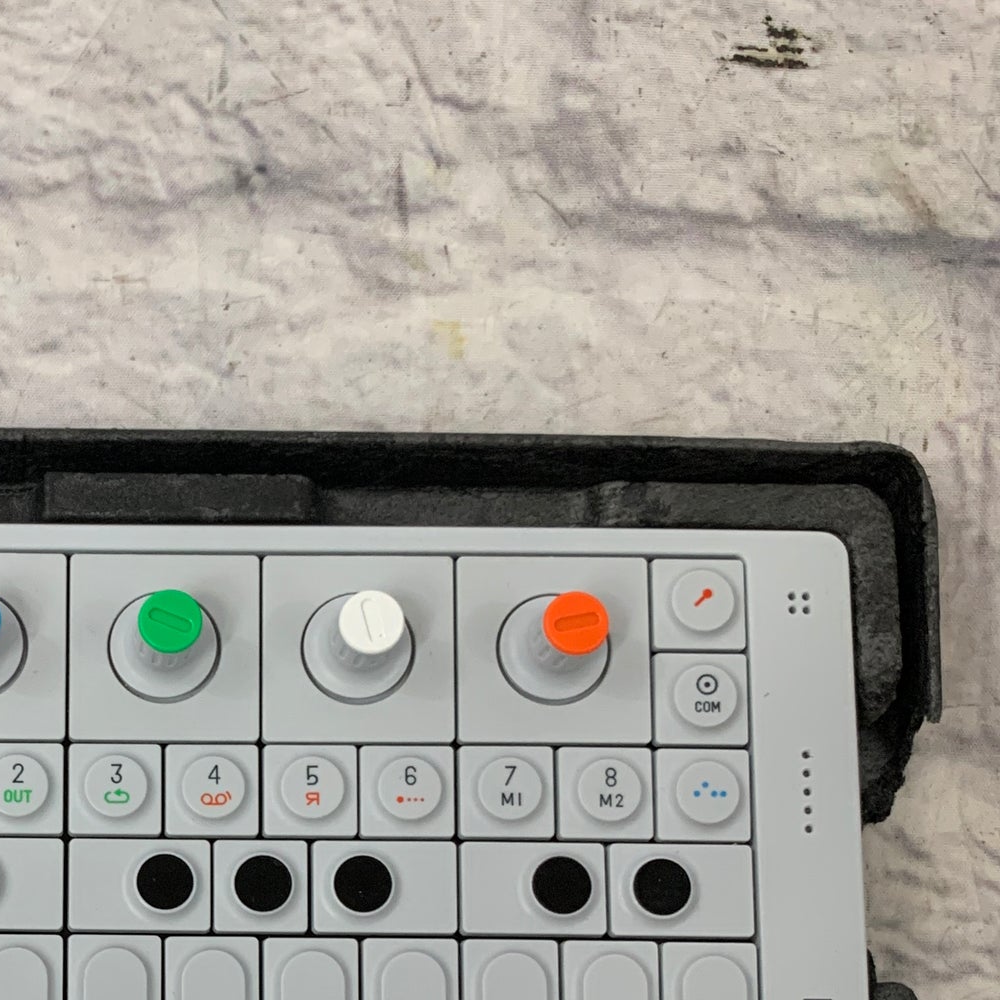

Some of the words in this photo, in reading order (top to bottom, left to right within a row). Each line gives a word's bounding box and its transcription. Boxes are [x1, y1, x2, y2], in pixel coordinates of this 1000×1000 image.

[695, 702, 721, 713] COM
[12, 763, 24, 784] 2
[111, 764, 122, 784] 3
[208, 765, 221, 784] 4
[306, 766, 319, 785] 5
[405, 767, 417, 786] 6
[505, 767, 517, 786] 7
[605, 768, 617, 787] 8
[3, 789, 32, 803] OUT
[600, 794, 623, 808] M2
